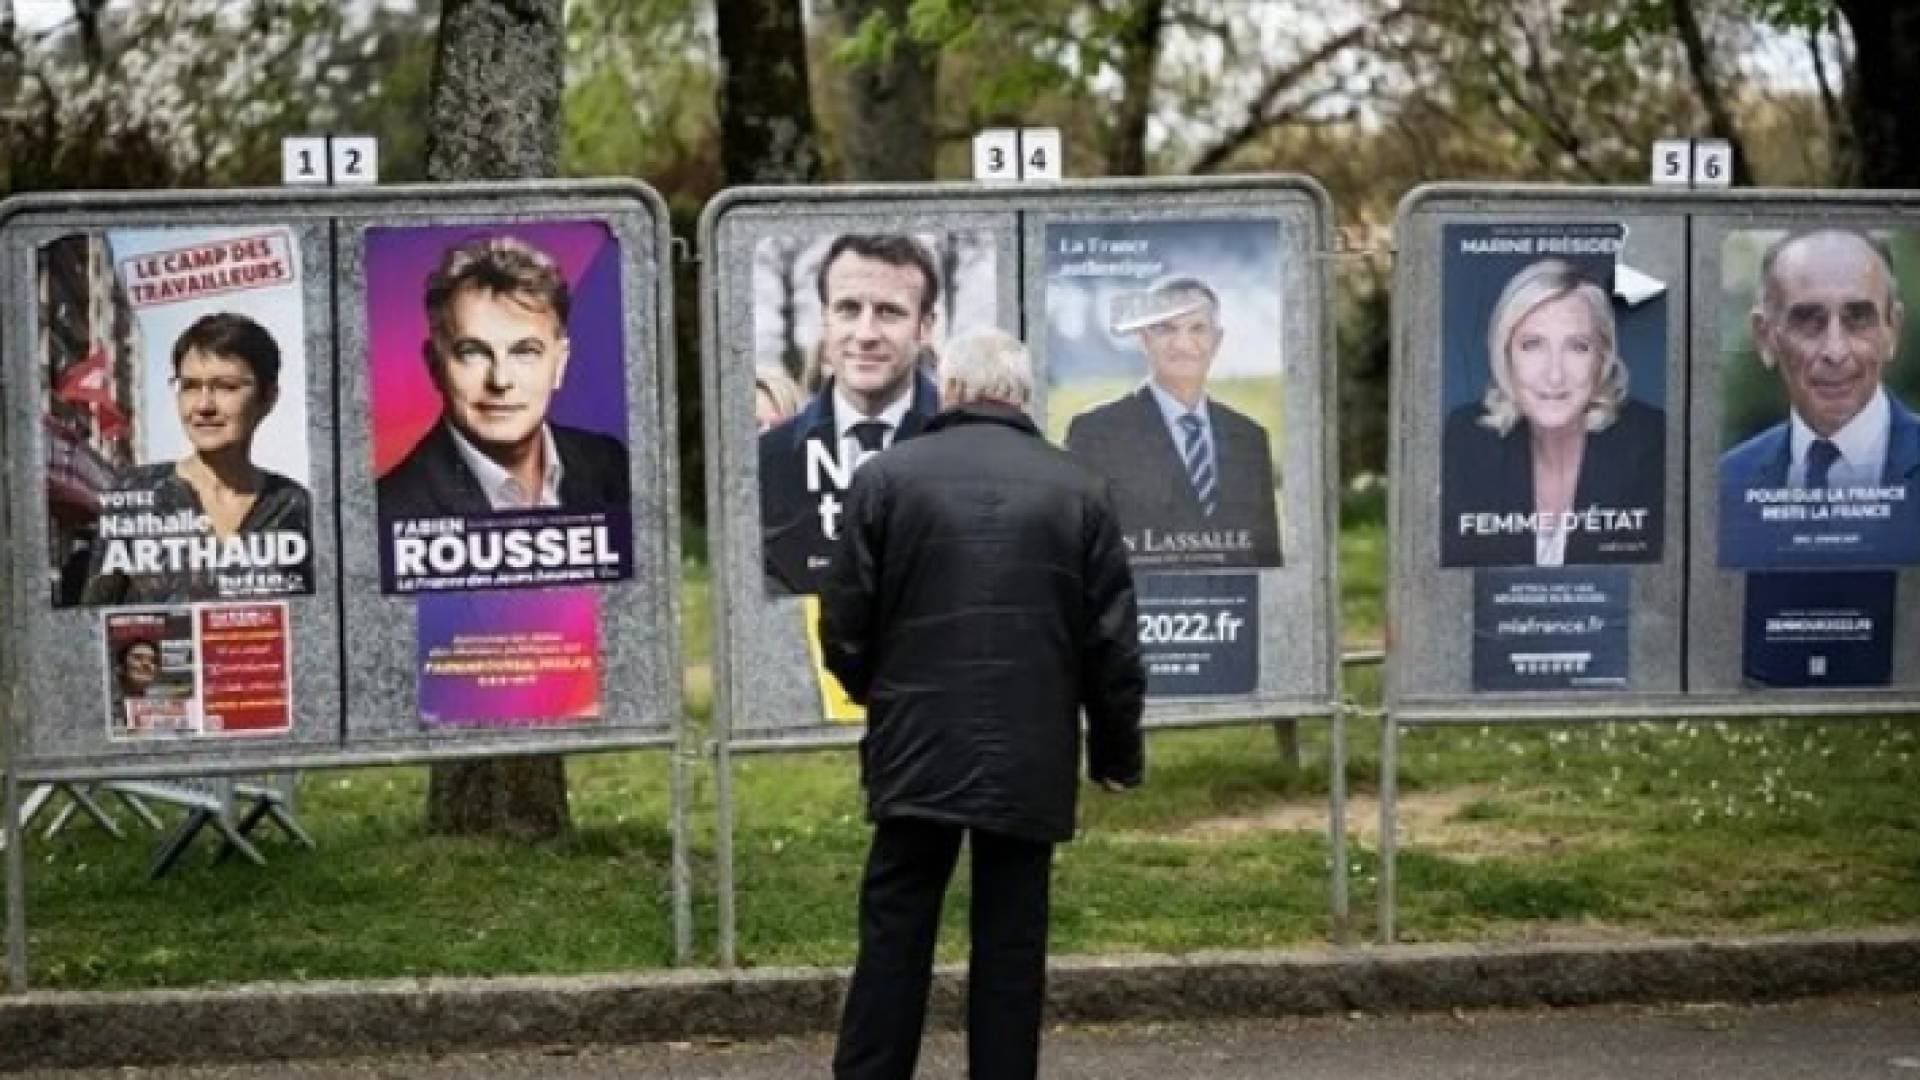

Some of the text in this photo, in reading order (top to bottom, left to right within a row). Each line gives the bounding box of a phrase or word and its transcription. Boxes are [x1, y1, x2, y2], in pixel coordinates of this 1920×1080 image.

[297, 150, 314, 175] 1
[345, 148, 362, 174] 2
[988, 147, 1004, 172] 3
[1030, 147, 1047, 171] 4
[1665, 150, 1680, 176] 5
[1704, 153, 1721, 179] 6
[1461, 238, 1531, 253] MARINE
[136, 239, 271, 279] LE CAMP DES
[132, 262, 283, 301] TRAVAILLEURS
[1849, 486, 1905, 501] FRANCE
[99, 509, 214, 538] Nathalie
[1459, 504, 1648, 535] FEMME D'ÉTAT
[1831, 503, 1892, 519] FRANCE
[393, 517, 465, 537] FABIEN
[101, 532, 307, 575] ARTHAUD
[394, 526, 620, 576] ROUSSEL
